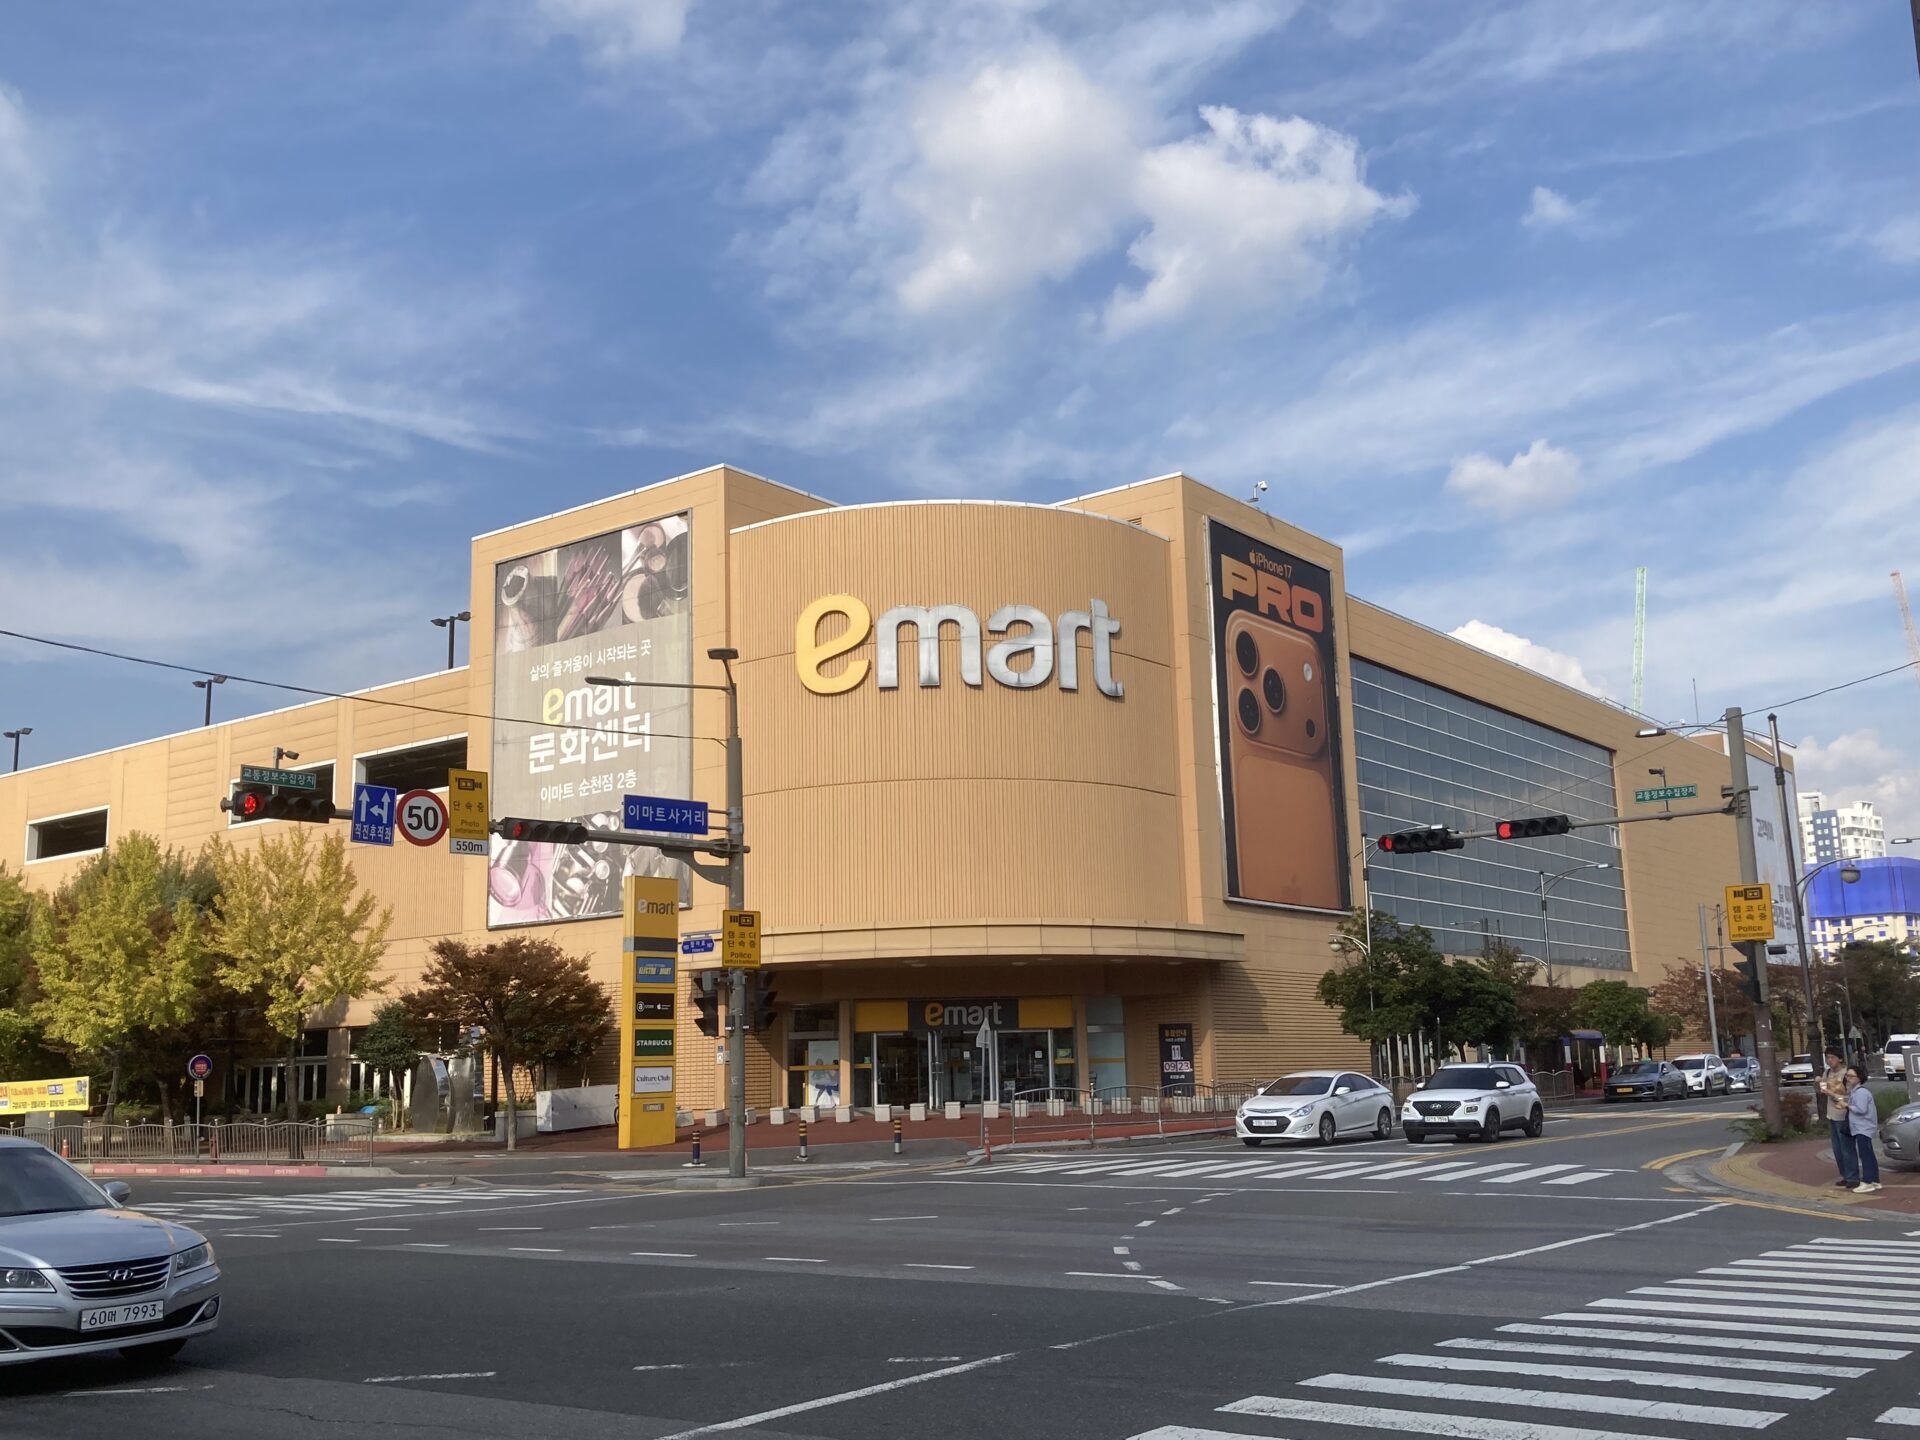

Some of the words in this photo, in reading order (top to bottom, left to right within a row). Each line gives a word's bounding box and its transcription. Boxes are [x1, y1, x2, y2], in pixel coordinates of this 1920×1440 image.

[1221, 553, 1323, 633] PRO
[795, 593, 1124, 698] emart
[530, 662, 550, 682] 삶의
[551, 652, 592, 676] 즐거움이
[596, 643, 637, 665] 시작되는
[641, 639, 652, 656] 곳
[542, 672, 636, 725] emart
[528, 712, 650, 774] 문화센터
[243, 768, 314, 786] 교통정보수집장치
[540, 780, 573, 803] 이마트
[578, 772, 613, 796] 순천점
[617, 769, 637, 790] 2층
[1636, 786, 1696, 800] 교통정보수집장치
[407, 805, 438, 831] 50
[628, 804, 705, 826] 이마트사거리
[355, 823, 391, 842] 직진후직좌
[456, 840, 483, 853] 550m
[638, 899, 675, 916] emart
[924, 1001, 1003, 1027] emart
[636, 1039, 672, 1047] STARBUCKS
[636, 1074, 657, 1082] Culture
[657, 1074, 671, 1082] Club
[124, 1304, 157, 1321] 7993
